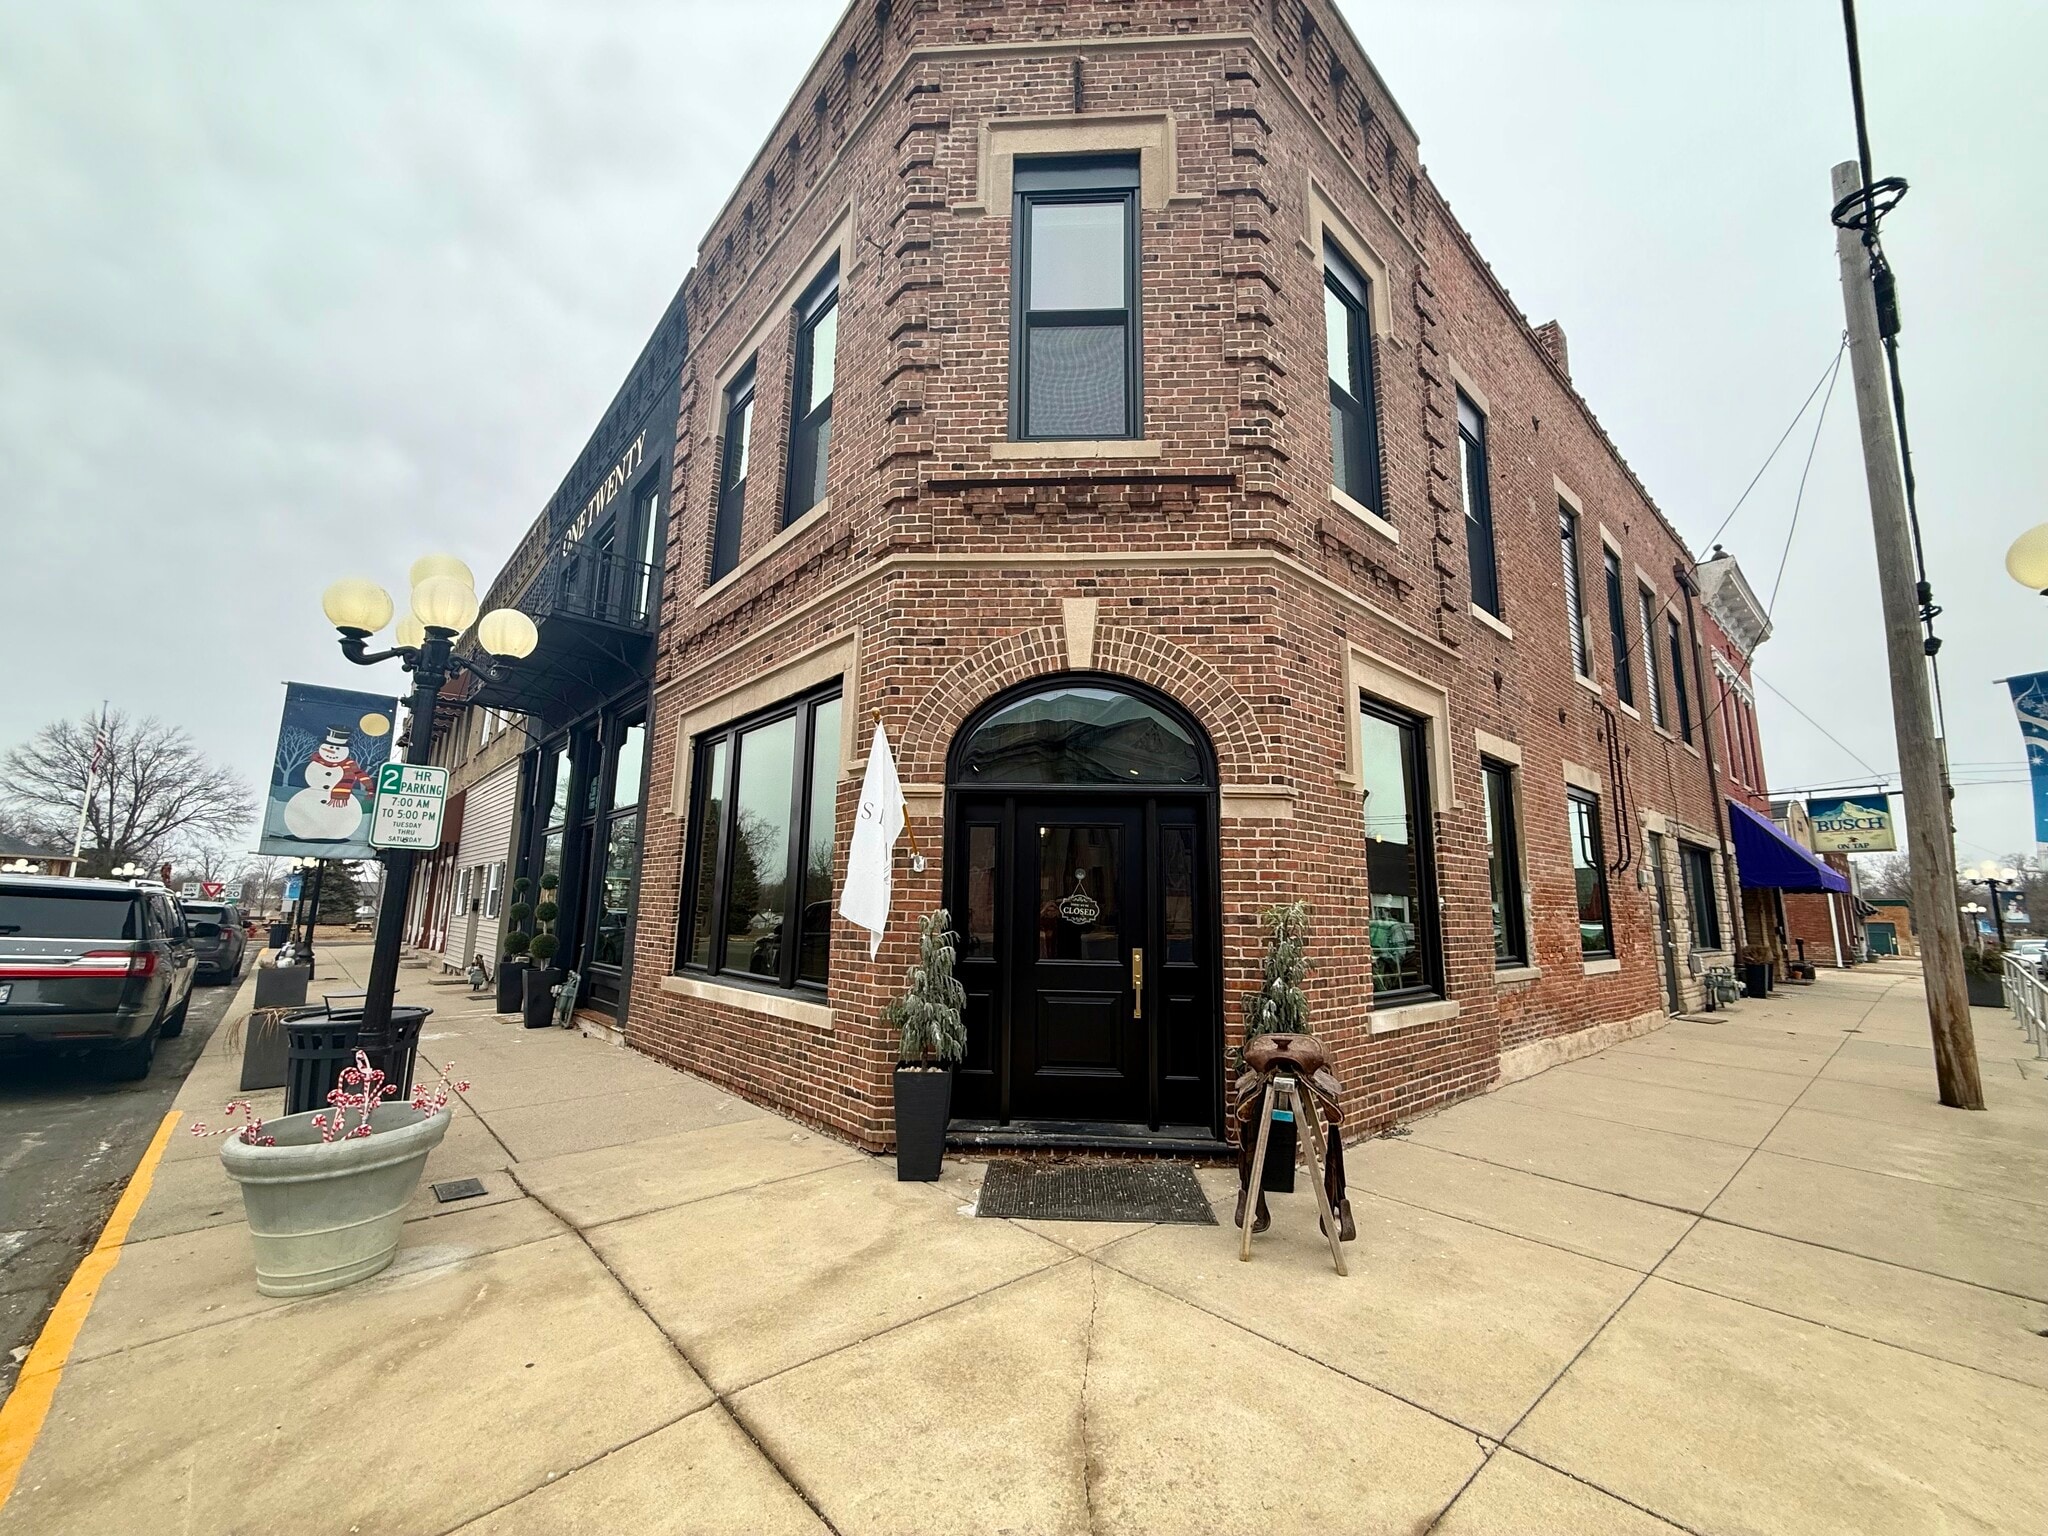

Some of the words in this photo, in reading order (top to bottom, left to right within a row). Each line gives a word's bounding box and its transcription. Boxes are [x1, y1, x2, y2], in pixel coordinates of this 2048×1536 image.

[563, 508, 587, 557] ONE
[587, 428, 647, 528] TWENTY
[382, 769, 399, 790] 2
[415, 771, 432, 782] HR
[400, 782, 442, 795] PARKING
[392, 797, 413, 807] 7:00
[416, 799, 430, 808] AM
[382, 808, 394, 818] TO
[397, 809, 419, 820] 5:00
[421, 811, 436, 821] PM
[392, 821, 422, 829] TUESDAY
[1814, 817, 1887, 833] BUSCH
[388, 835, 422, 843] SATURDAY
[226, 890, 240, 898] 20
[1063, 906, 1096, 916] CLOSED
